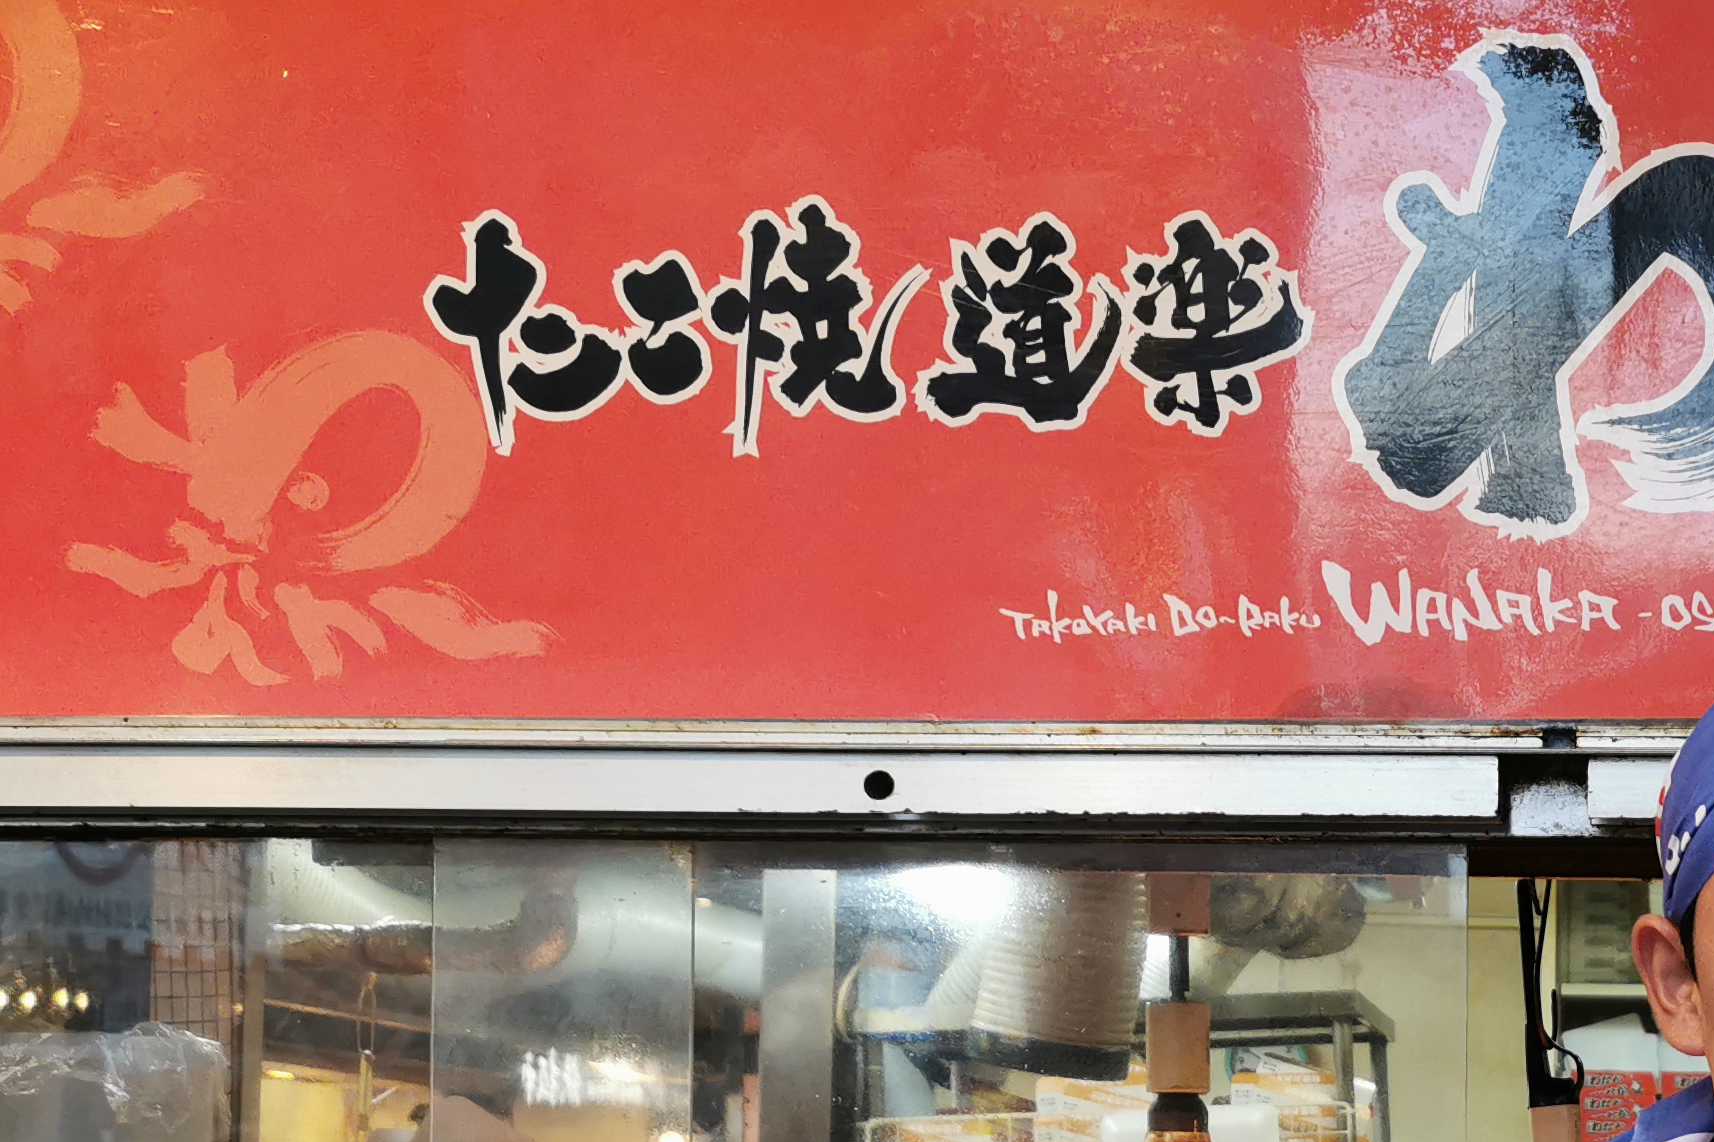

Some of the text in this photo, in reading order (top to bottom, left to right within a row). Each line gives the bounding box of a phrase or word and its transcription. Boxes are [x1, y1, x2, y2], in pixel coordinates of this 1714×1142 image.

[428, 200, 1308, 452] たこ焼道楽
